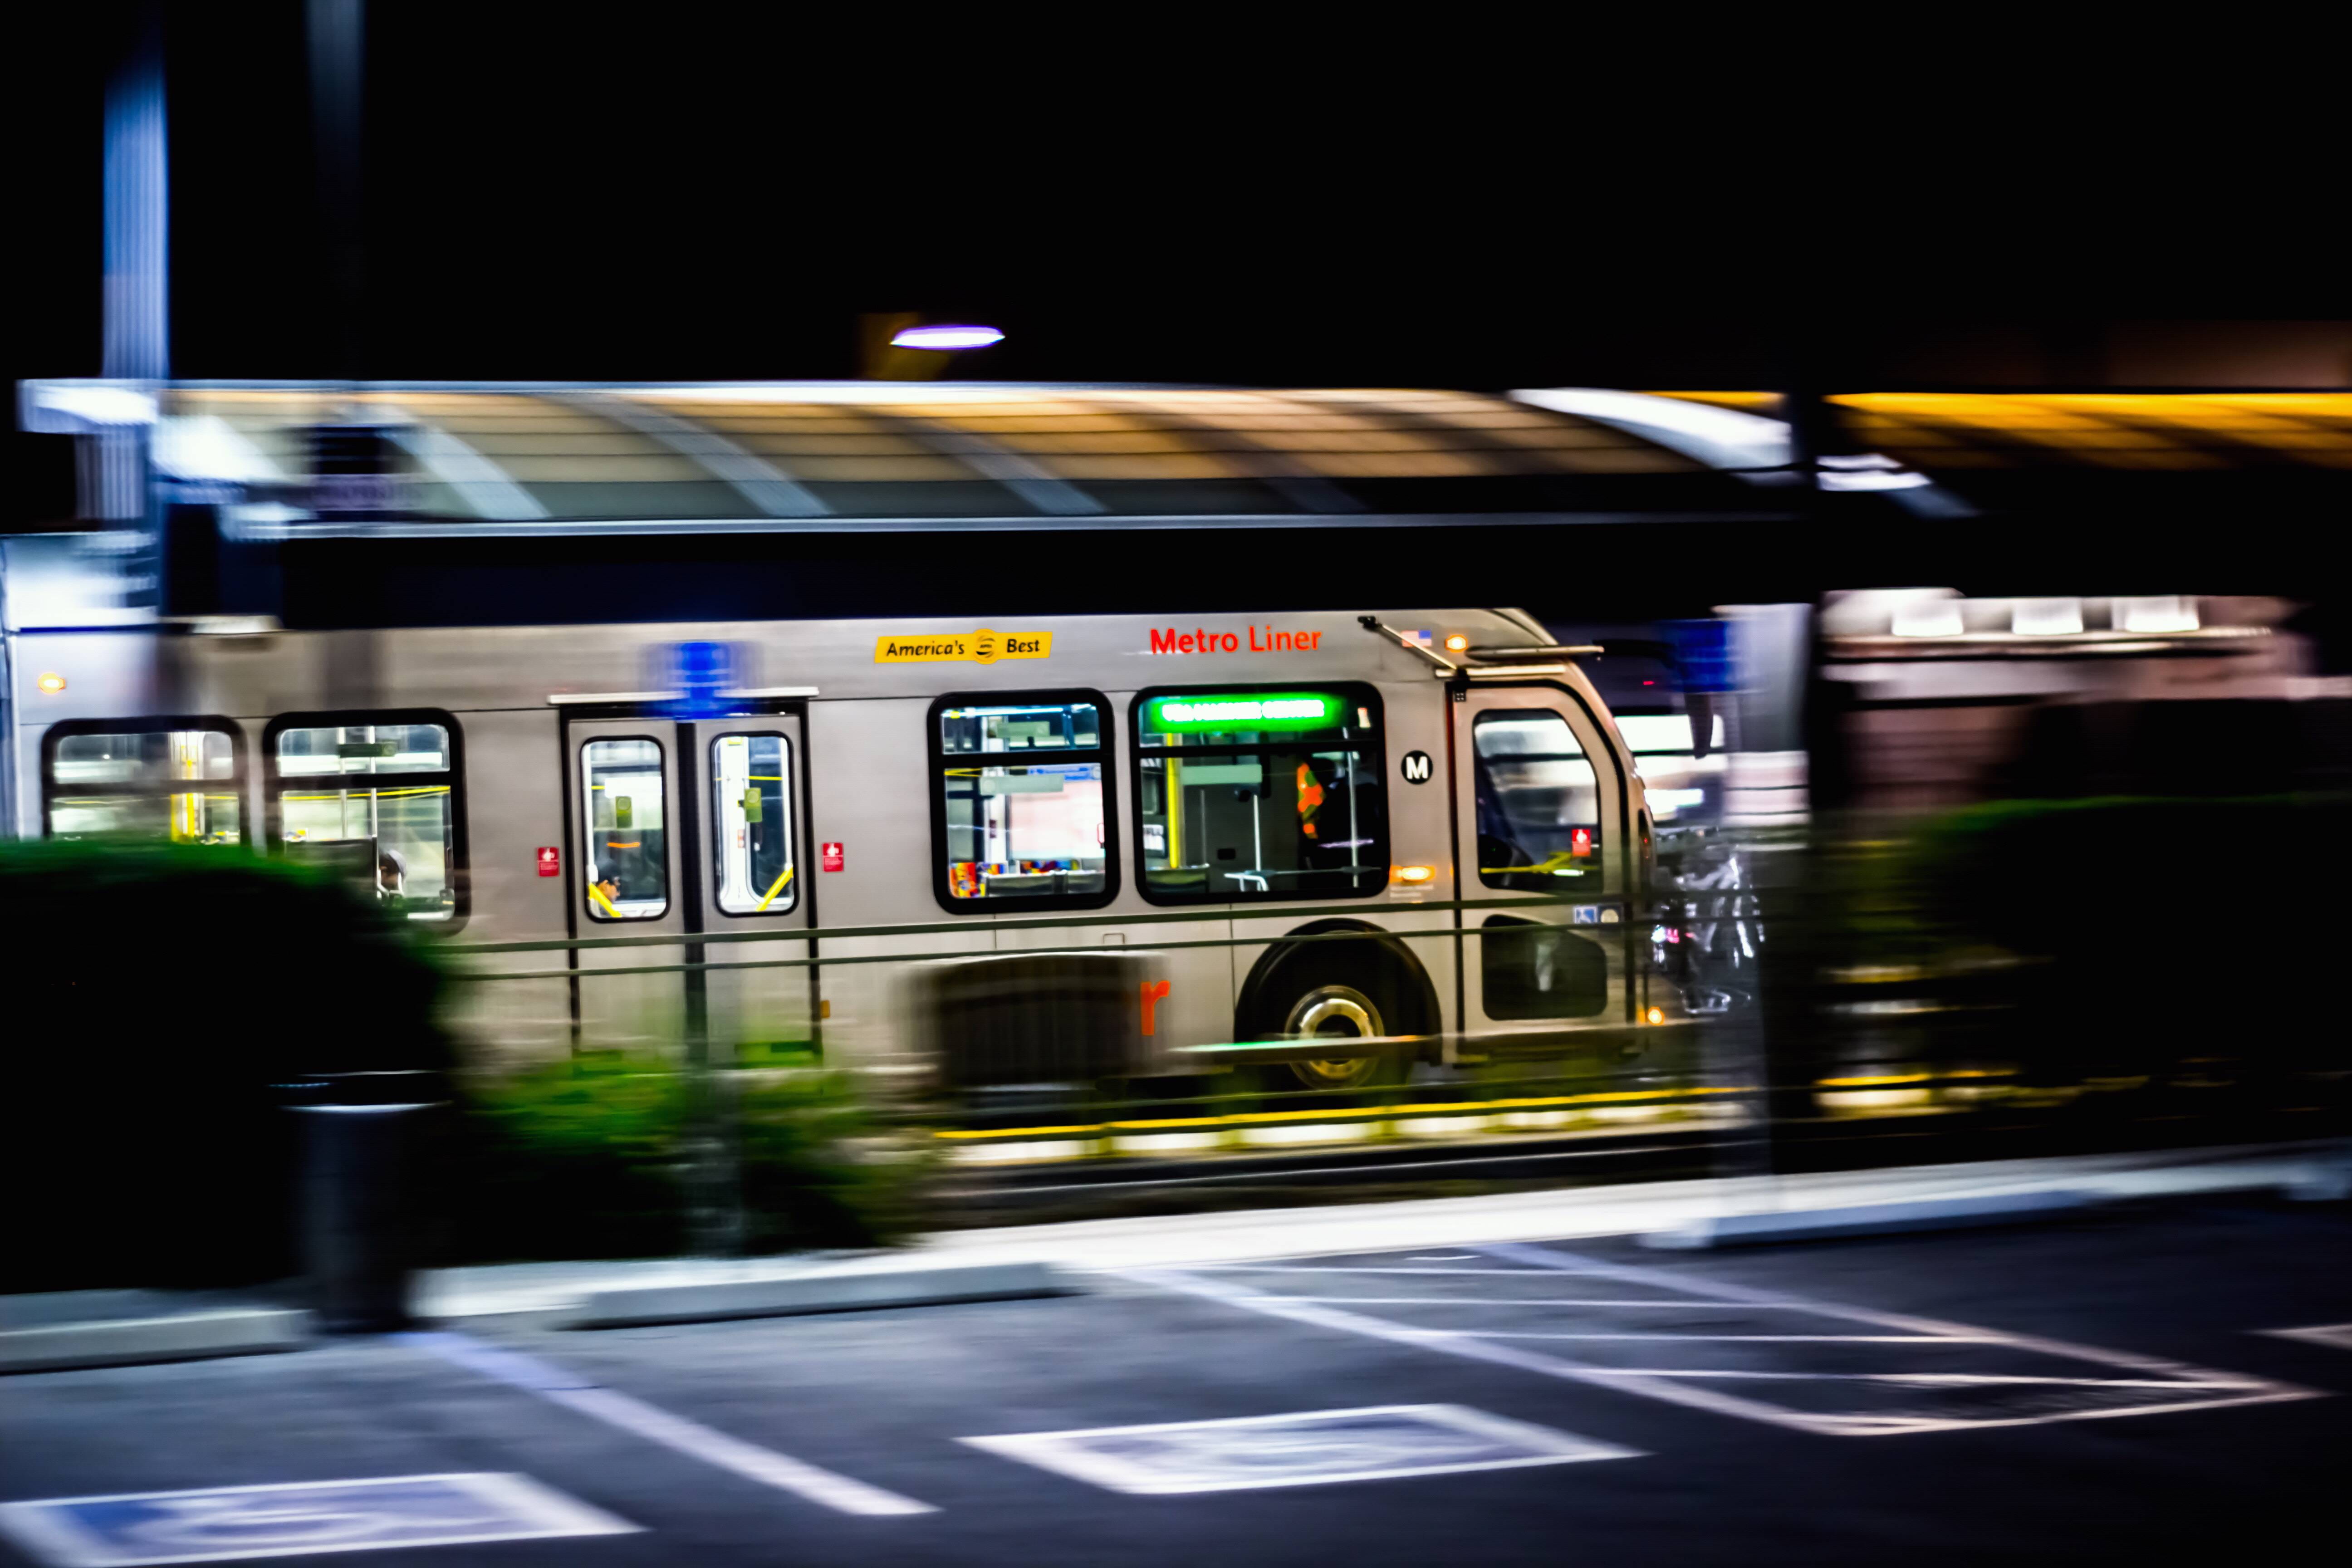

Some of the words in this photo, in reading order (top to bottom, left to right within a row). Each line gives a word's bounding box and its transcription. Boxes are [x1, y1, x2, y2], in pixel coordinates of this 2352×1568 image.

[886, 640, 965, 657] America's
[1006, 639, 1040, 653] Best
[1150, 628, 1239, 654] Metro
[1249, 625, 1322, 652] Liner
[1406, 755, 1428, 779] M
